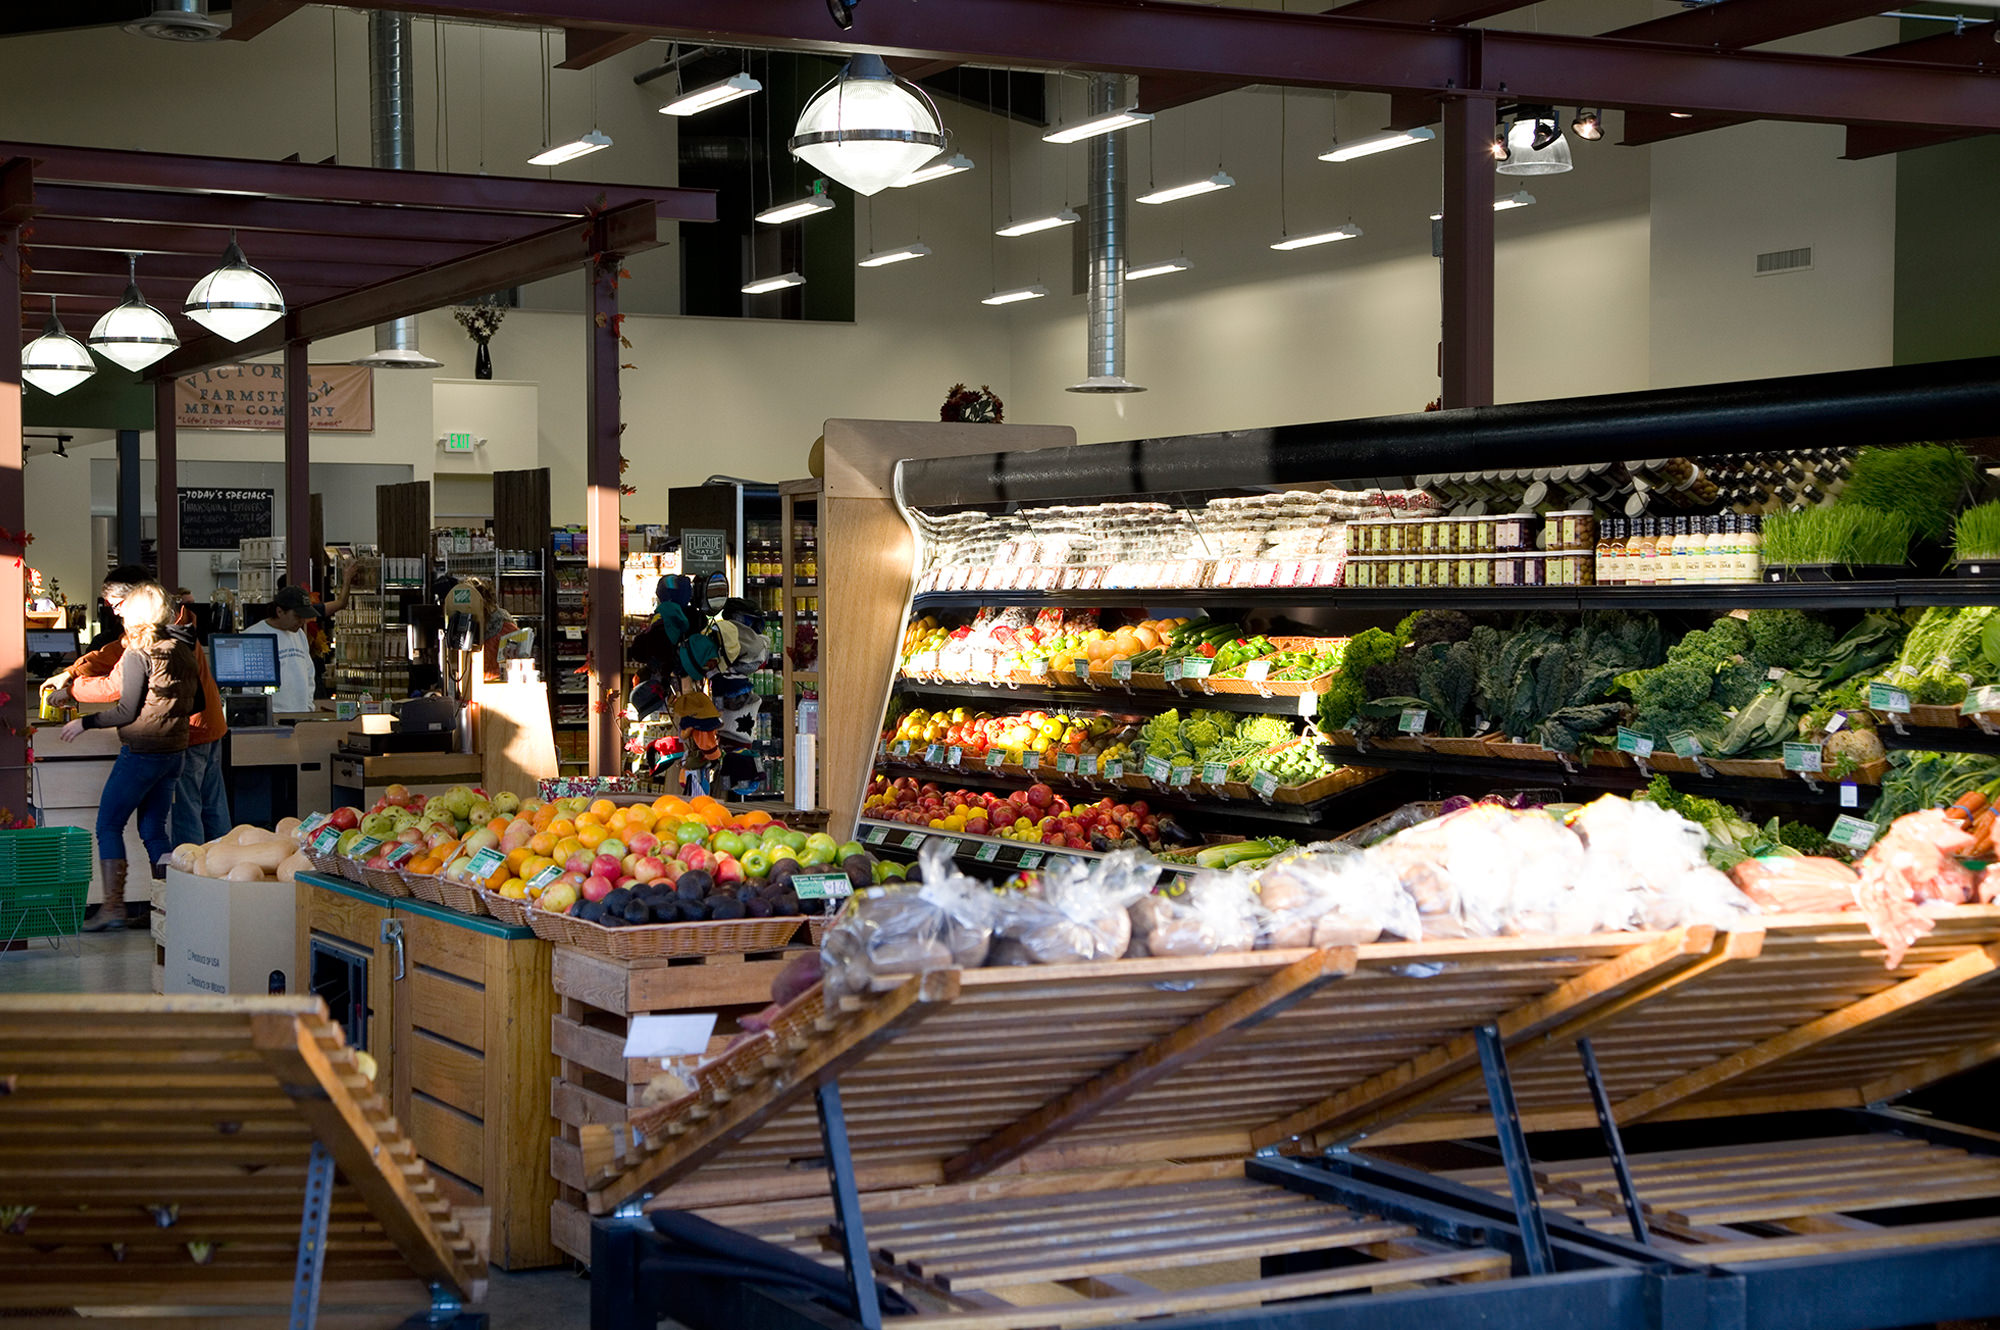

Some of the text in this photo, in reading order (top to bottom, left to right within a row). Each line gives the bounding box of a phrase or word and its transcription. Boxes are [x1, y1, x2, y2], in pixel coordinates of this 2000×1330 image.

[199, 388, 319, 403] FARMSTD
[185, 403, 335, 417] MEAT COMNY
[228, 416, 252, 426] short
[450, 433, 470, 449] EXIT
[187, 490, 267, 500] TODAY'S SPECIALS
[689, 537, 720, 549] FLIPSIDE
